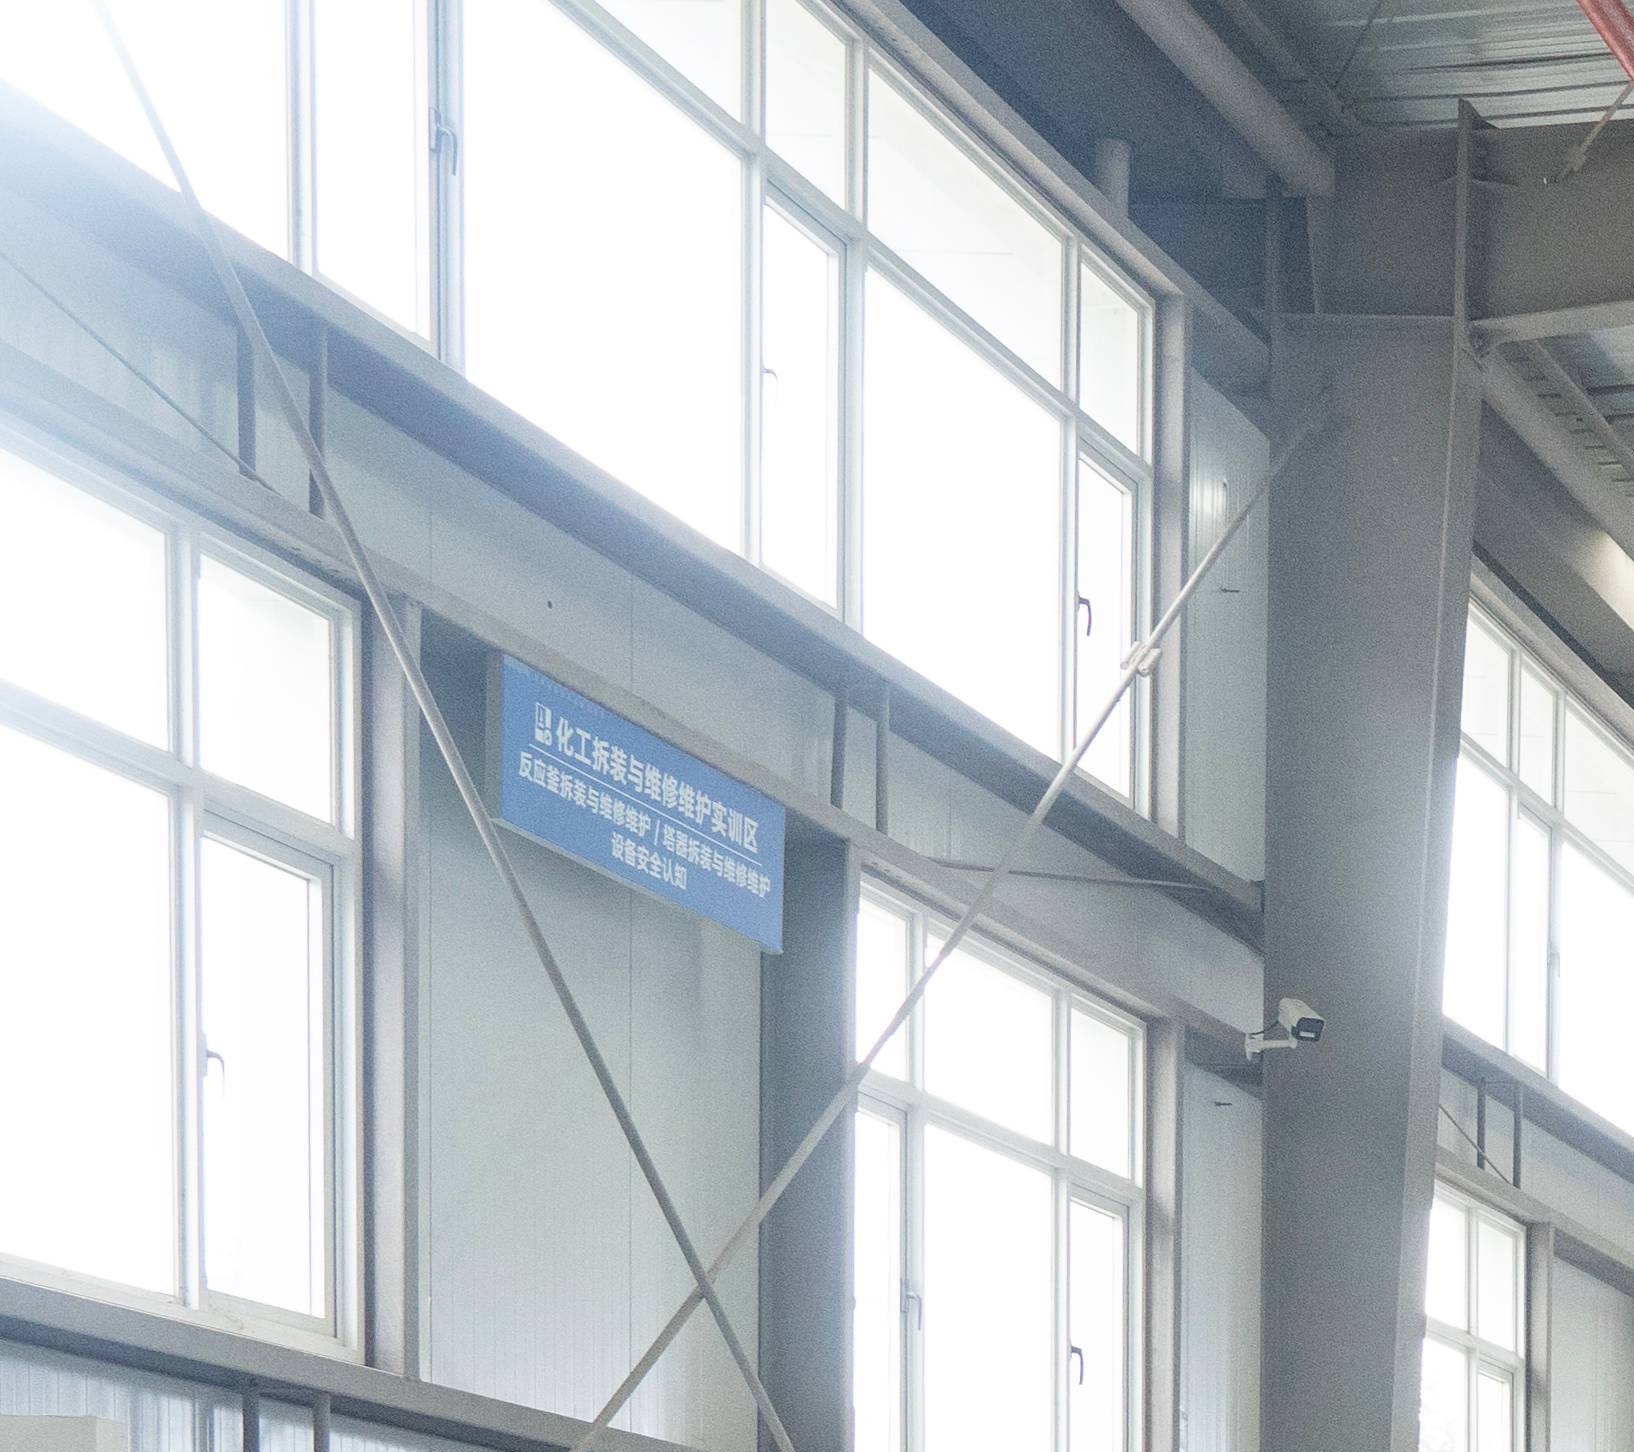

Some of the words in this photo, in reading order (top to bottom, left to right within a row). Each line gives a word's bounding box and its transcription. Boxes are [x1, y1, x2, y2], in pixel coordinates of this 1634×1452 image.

[556, 717, 758, 852] 化工拆装与维修维护实训区
